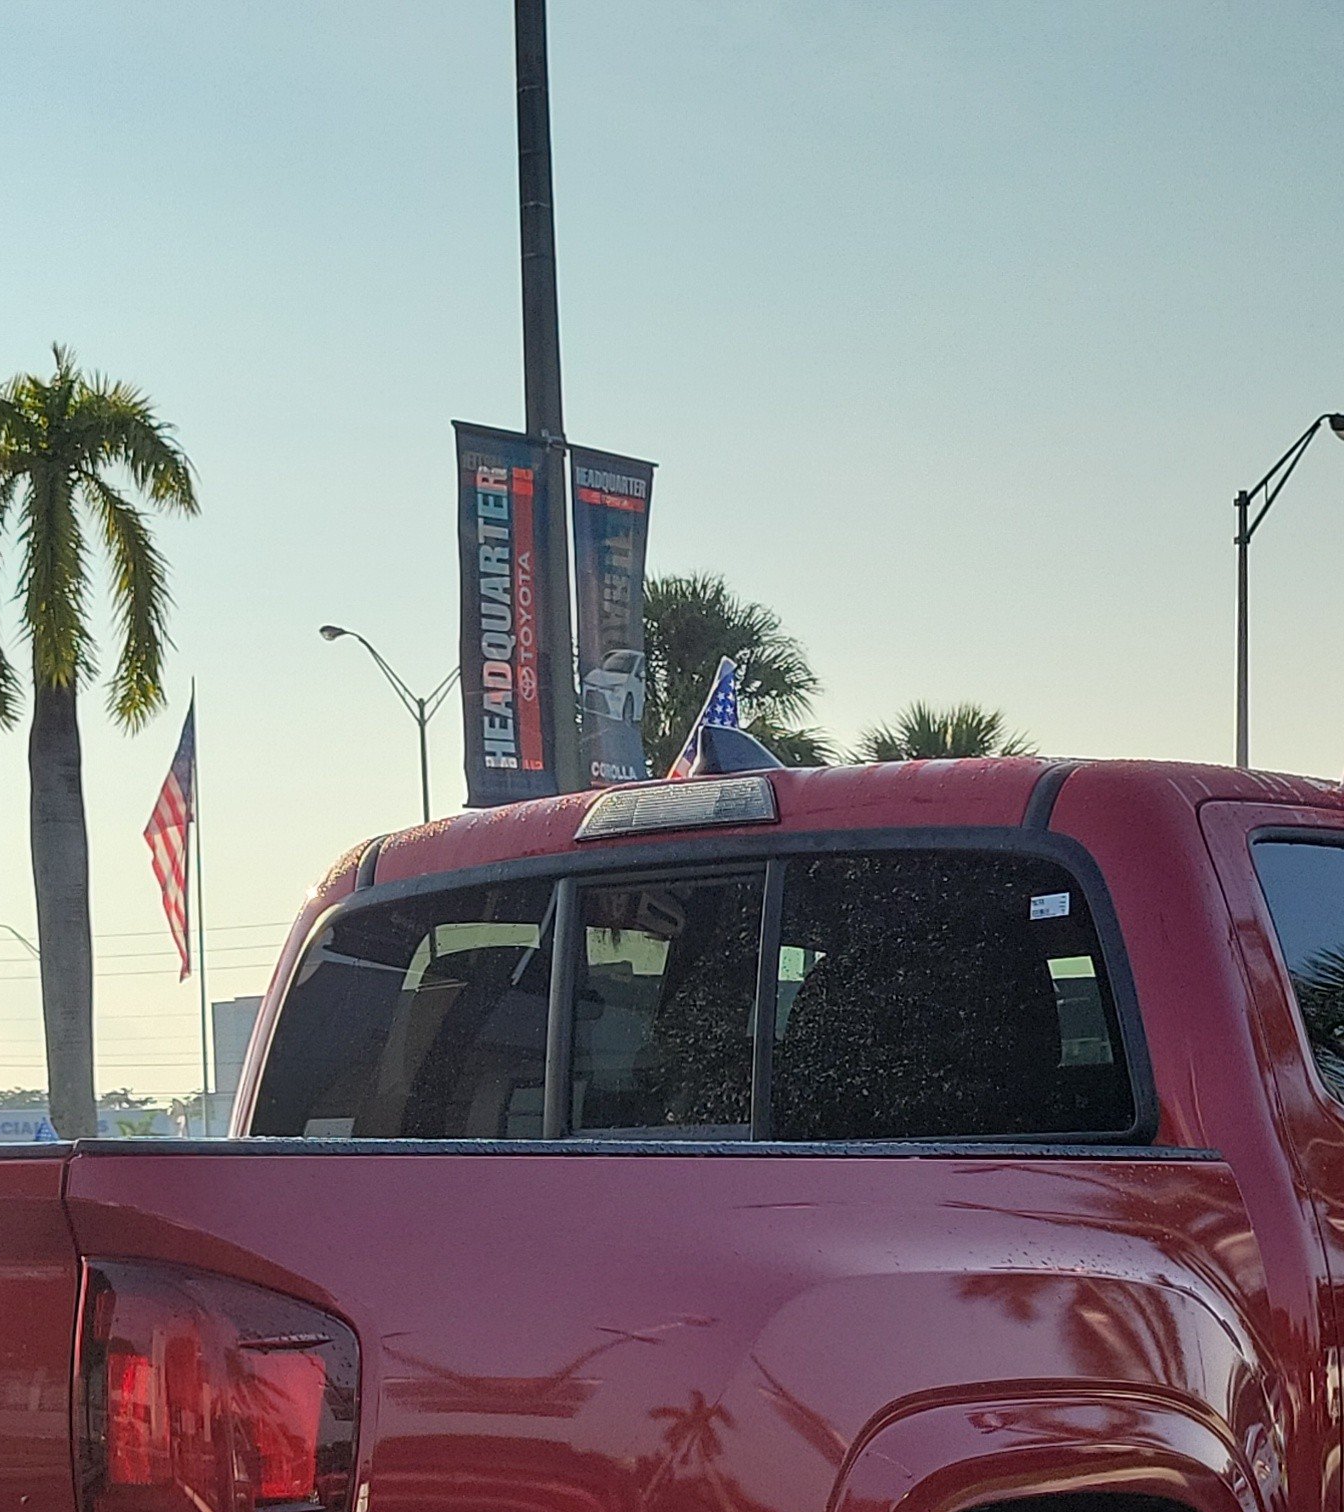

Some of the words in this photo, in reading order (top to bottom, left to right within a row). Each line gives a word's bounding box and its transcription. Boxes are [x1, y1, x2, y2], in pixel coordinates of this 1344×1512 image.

[576, 466, 646, 499] HEADQUARTER
[476, 465, 518, 769] HEADQUARTER
[517, 551, 534, 660] TOYOTA
[591, 761, 638, 780] COROLLA
